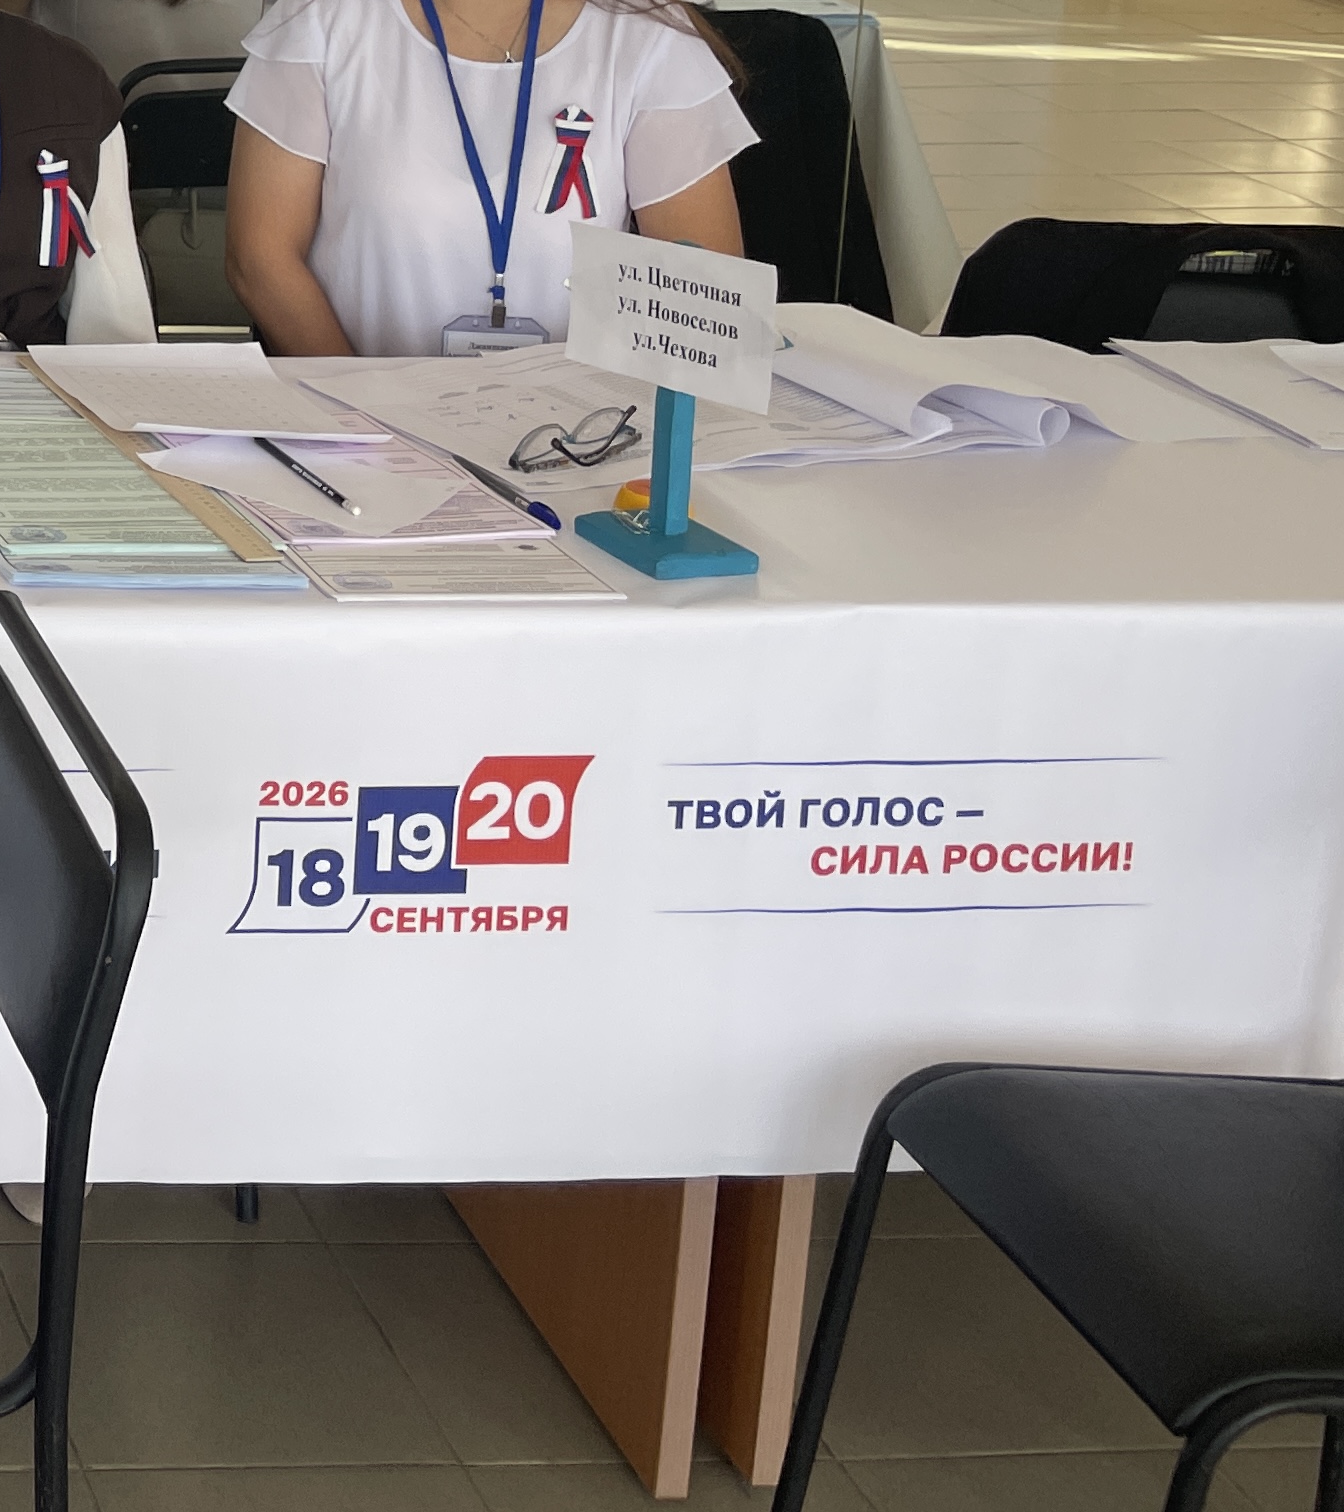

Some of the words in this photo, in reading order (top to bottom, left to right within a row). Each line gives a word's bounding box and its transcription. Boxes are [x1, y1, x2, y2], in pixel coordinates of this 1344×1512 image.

[618, 263, 642, 282] ул.
[648, 266, 742, 307] Цветочная
[617, 295, 642, 314] ул.
[647, 298, 739, 339] Новоселов
[259, 780, 350, 807] 2026
[667, 790, 786, 830] ТВОЙ
[798, 797, 945, 828] ГОЛОС
[267, 849, 346, 907] 18
[367, 813, 447, 873] 19
[466, 780, 565, 841] 20
[810, 845, 930, 877] СИЛА
[942, 841, 1135, 874] РОССИИ!
[369, 905, 569, 934] СЕНТЯБРЯ
